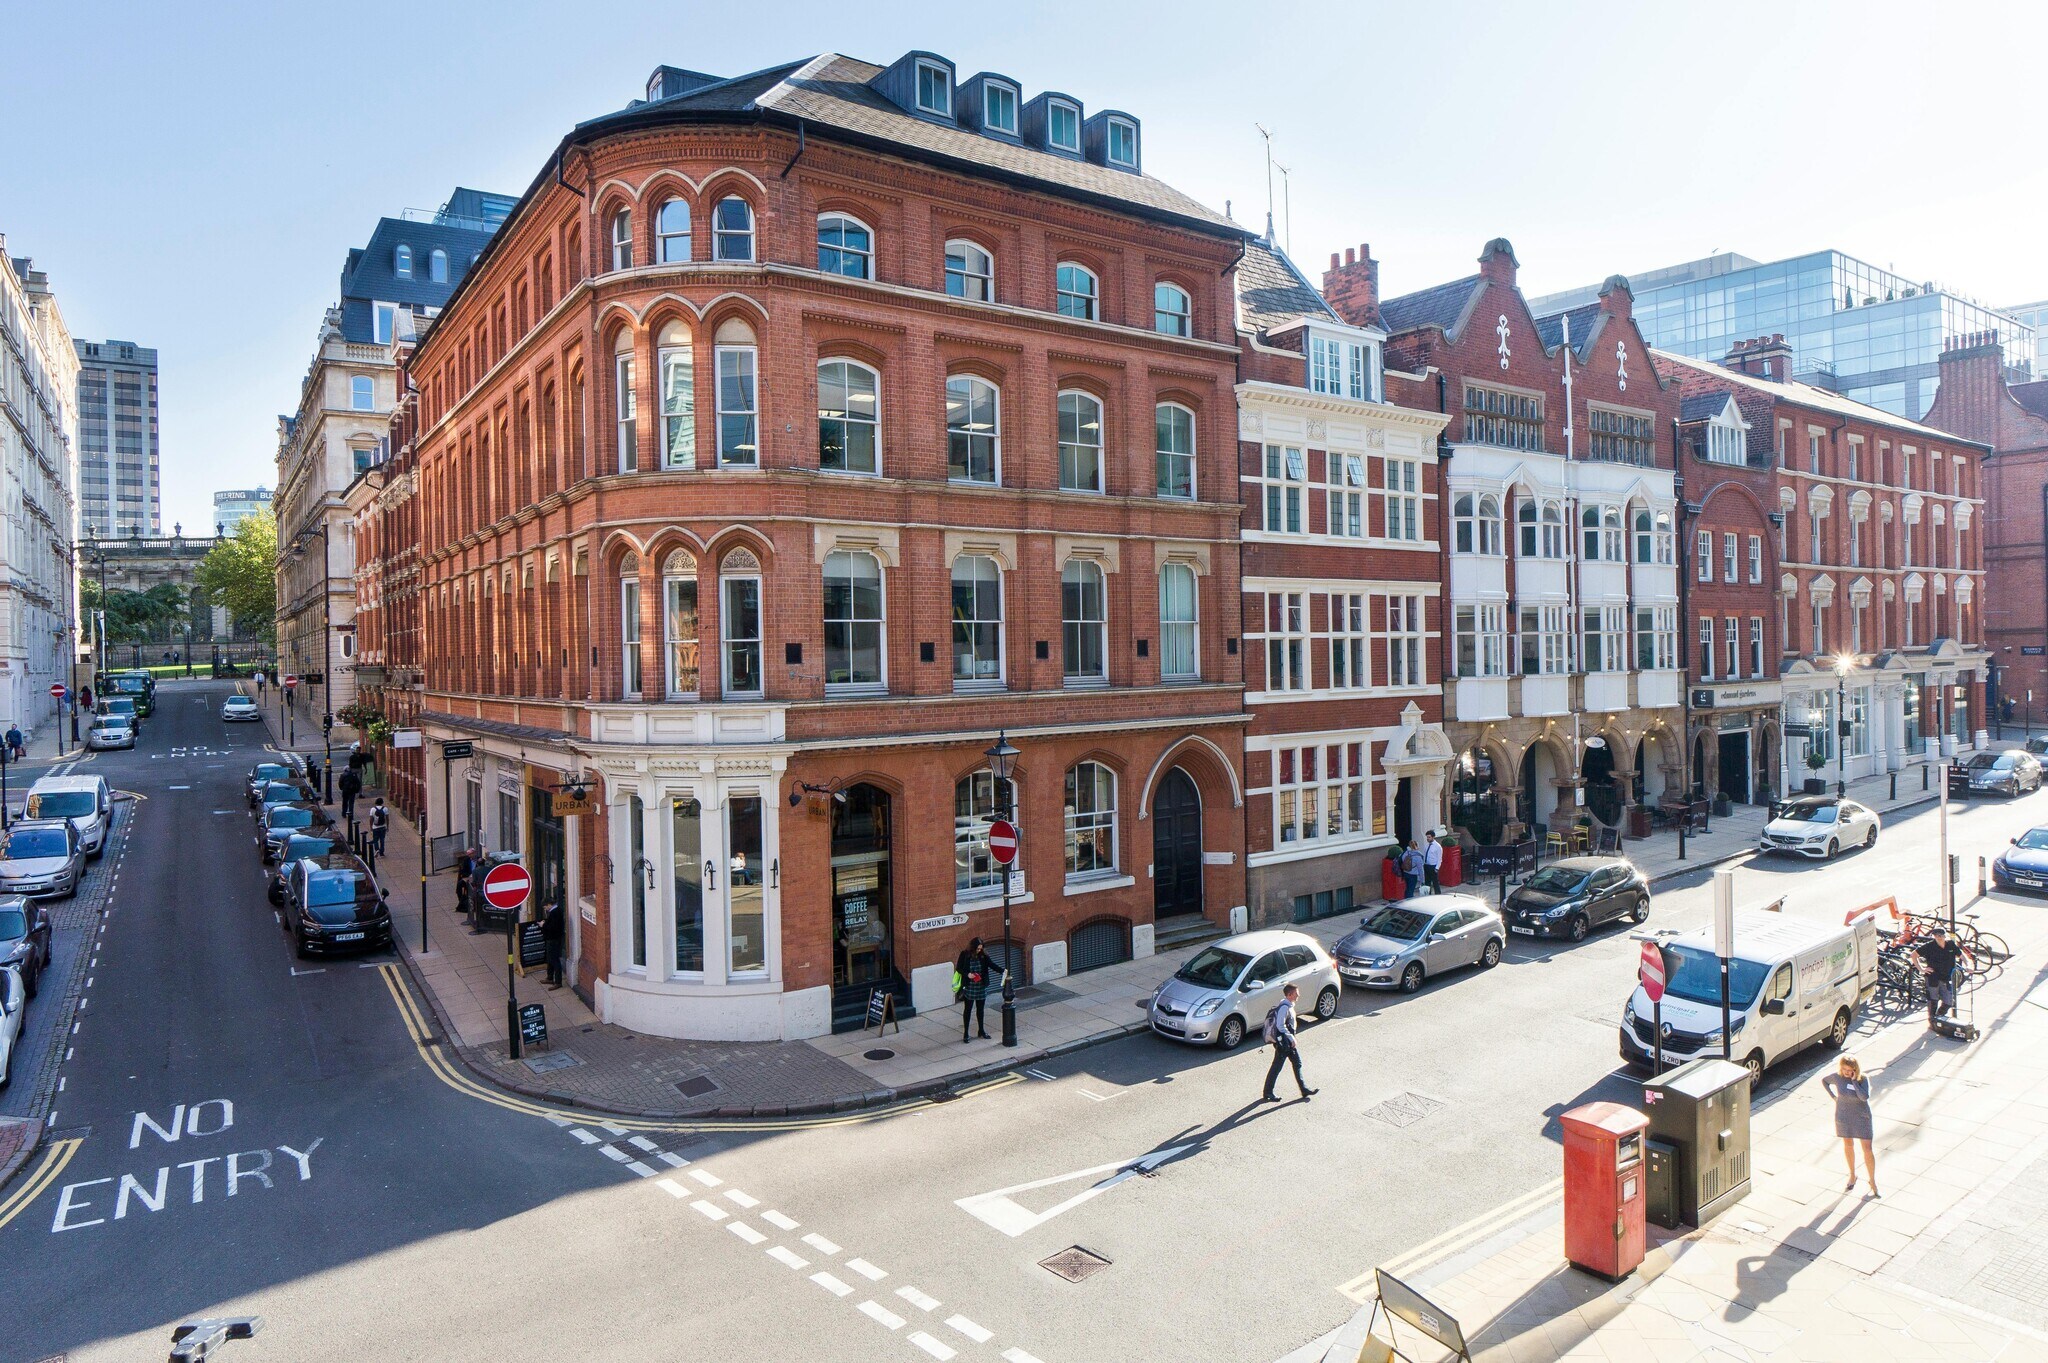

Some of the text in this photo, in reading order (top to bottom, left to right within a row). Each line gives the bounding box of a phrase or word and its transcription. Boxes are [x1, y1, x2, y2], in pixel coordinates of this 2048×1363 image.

[555, 800, 590, 810] URBAN
[844, 901, 868, 914] COFFEE
[845, 916, 868, 925] RELAX
[917, 919, 946, 929] EDMUND
[1801, 956, 1825, 977] principal
[129, 1099, 233, 1149] NO
[51, 1137, 324, 1233] ENTRY
